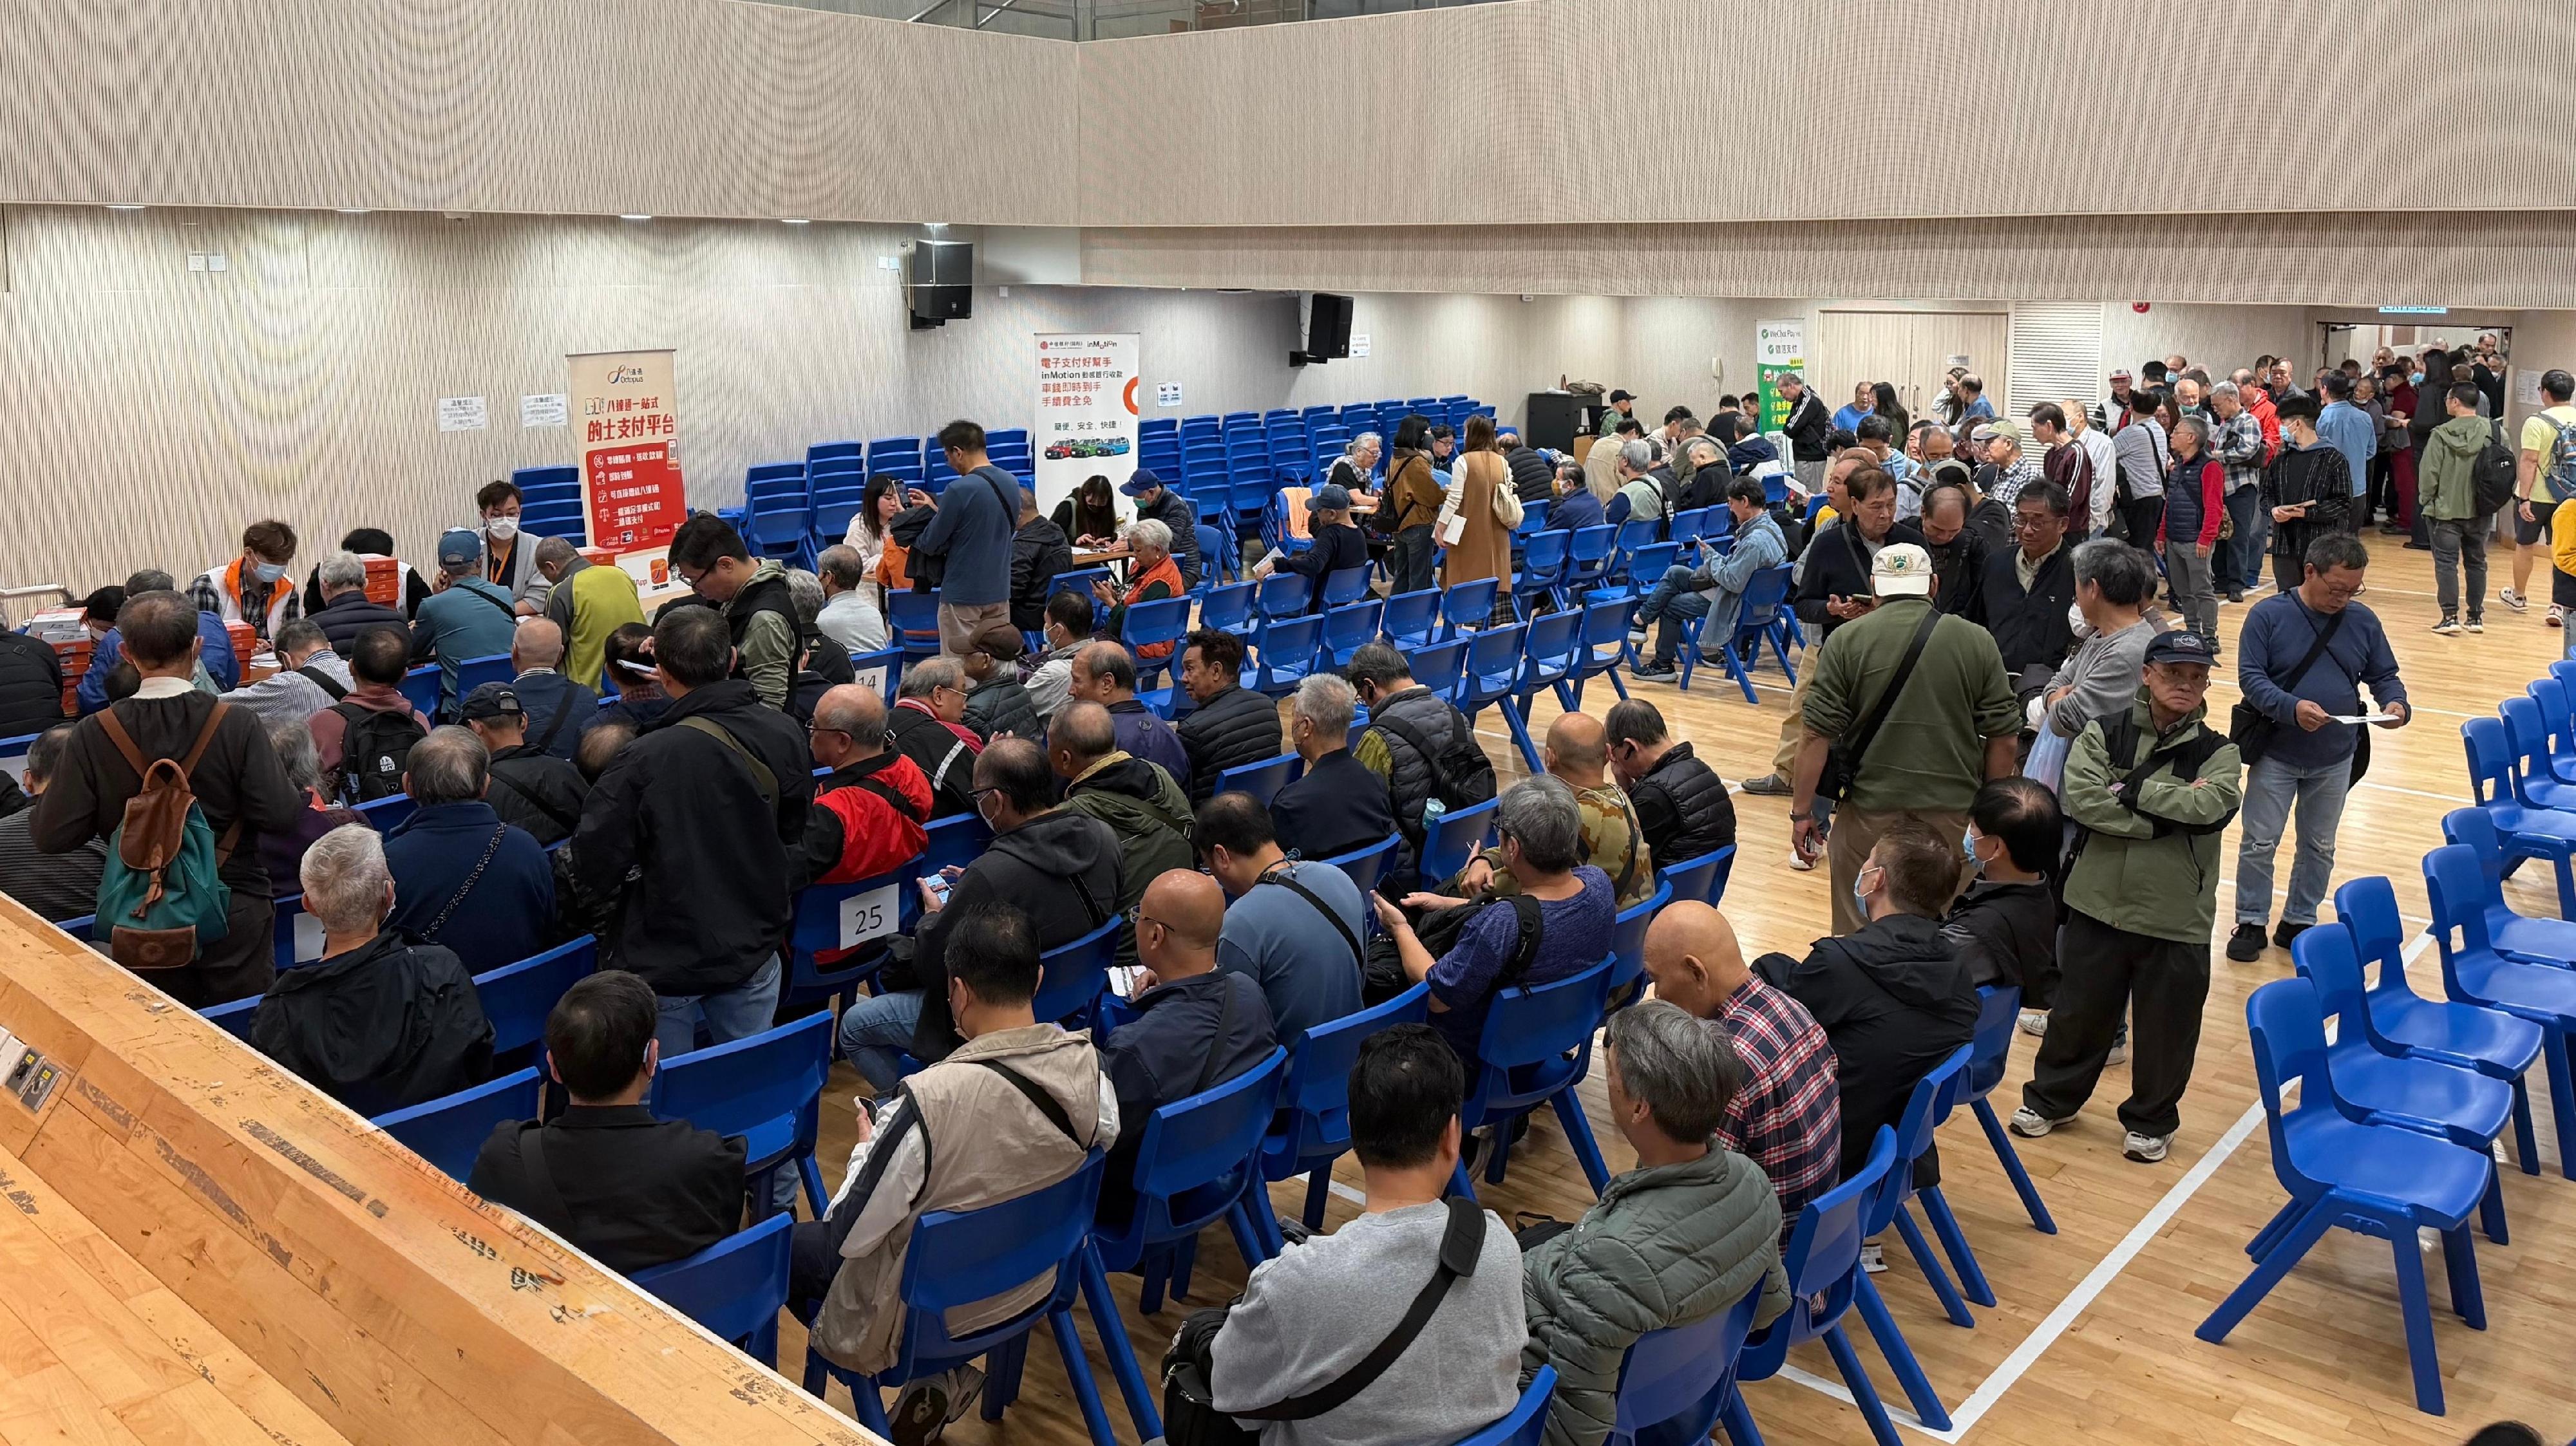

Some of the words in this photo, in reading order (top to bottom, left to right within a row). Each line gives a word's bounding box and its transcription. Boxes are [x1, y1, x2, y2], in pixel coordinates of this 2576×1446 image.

[1041, 357, 1112, 368] 電子支付好幫手
[1041, 371, 1080, 379] inMotion
[1041, 382, 1101, 394] 車錢即時到手
[607, 397, 658, 412] 八達通一站式
[1041, 395, 1092, 407] 手續費全免
[588, 413, 674, 442] 的士支付平台
[859, 675, 876, 689] 14
[855, 905, 882, 935] 25
